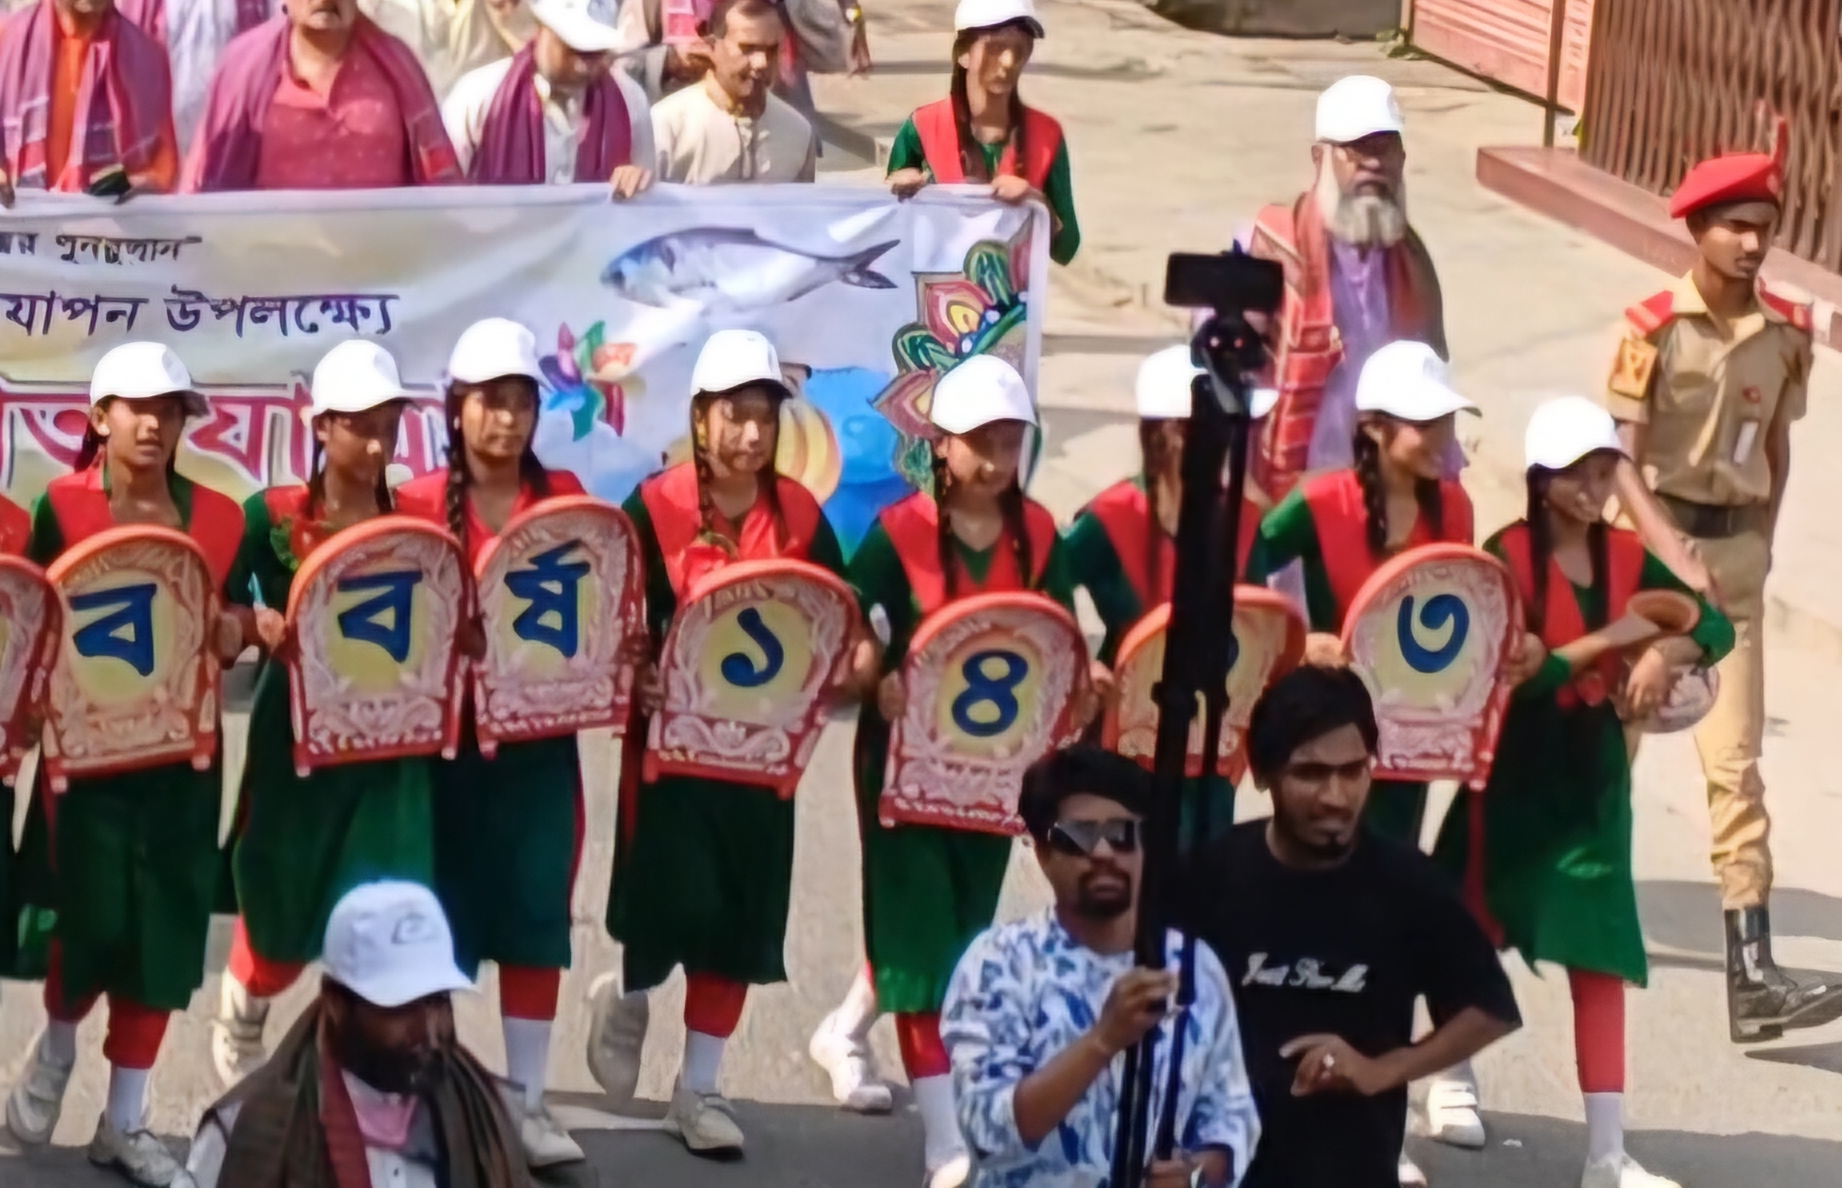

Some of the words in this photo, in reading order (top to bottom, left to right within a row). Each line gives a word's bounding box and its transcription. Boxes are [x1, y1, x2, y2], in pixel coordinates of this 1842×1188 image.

[69, 582, 158, 677] ব
[337, 570, 423, 663] ব
[504, 539, 592, 659] র্ষ
[1396, 592, 1469, 674] ৩
[719, 608, 784, 688] ১
[951, 649, 1029, 737] ৪
